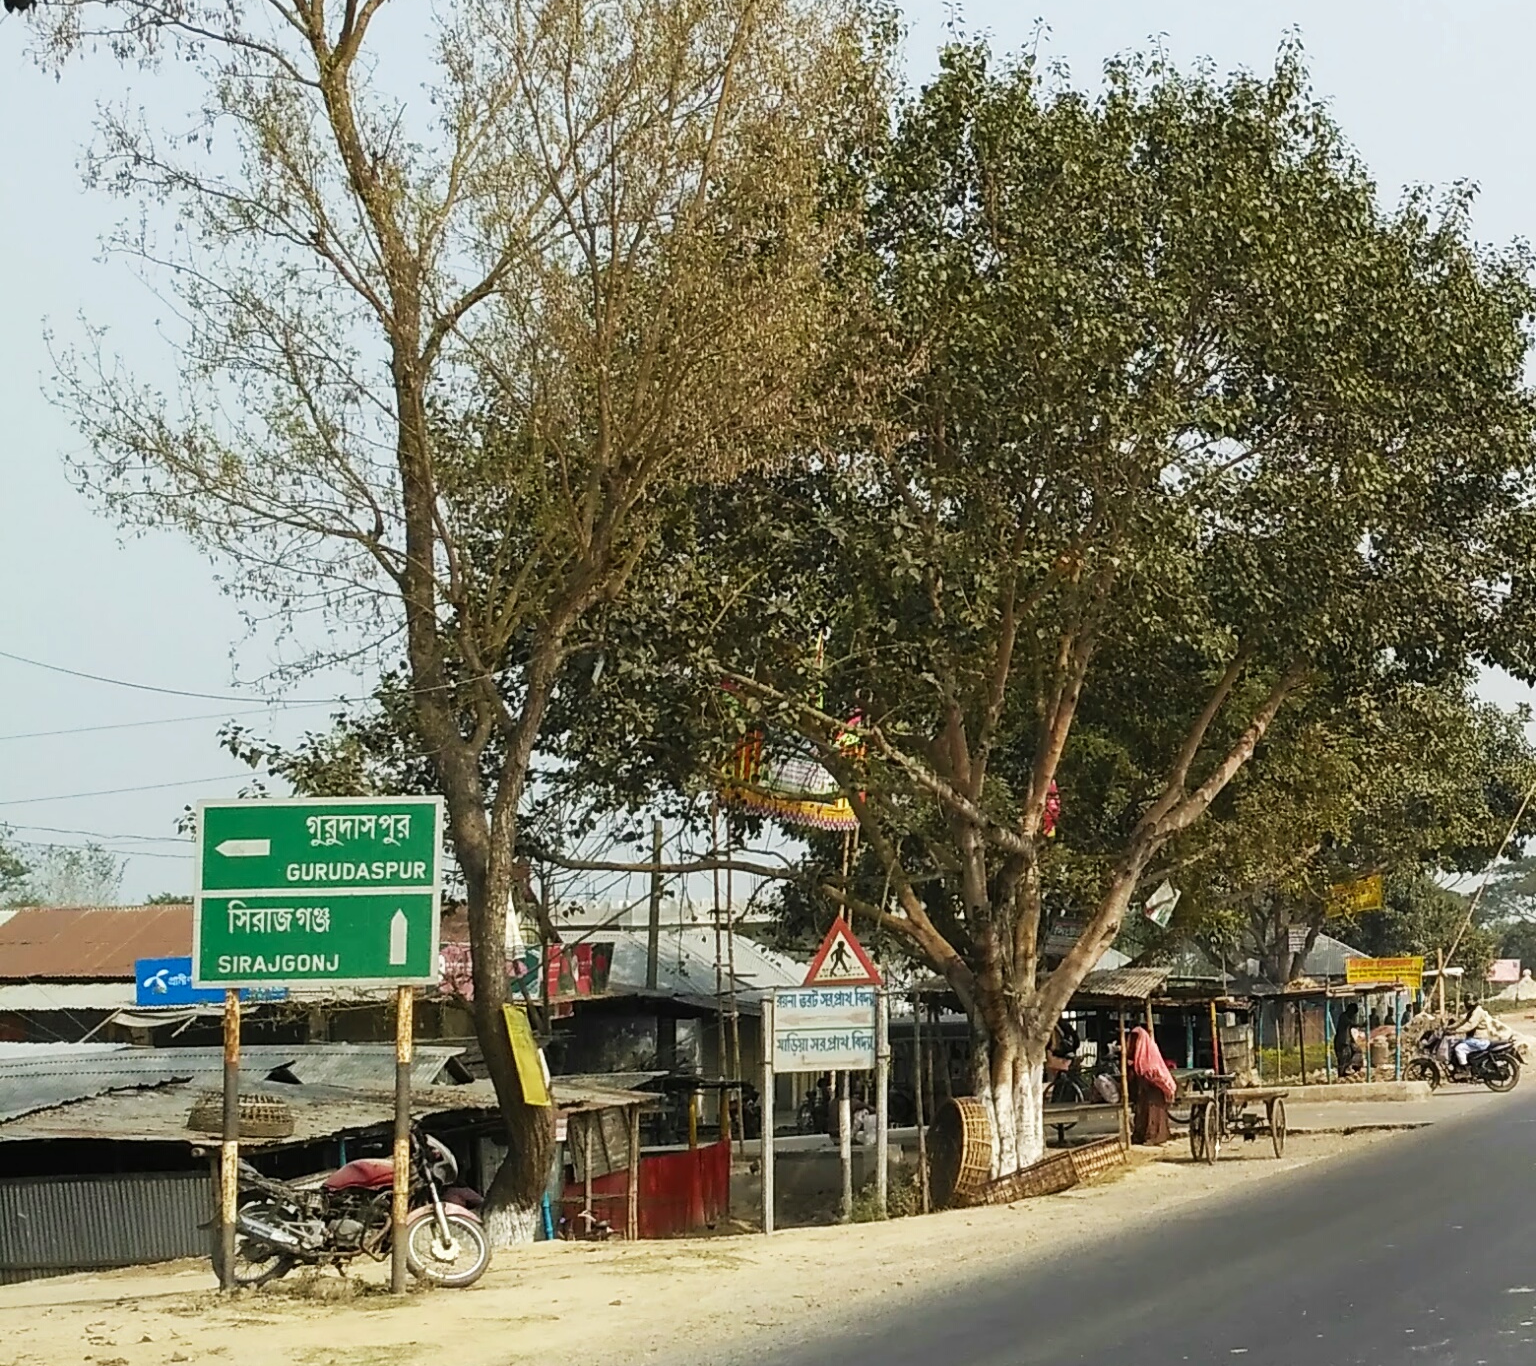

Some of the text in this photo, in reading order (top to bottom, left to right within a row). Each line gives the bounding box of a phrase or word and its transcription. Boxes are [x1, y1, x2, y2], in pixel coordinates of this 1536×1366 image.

[306, 815, 411, 846] গুরুদাসপুর
[286, 862, 426, 881] GURUDASPUR
[218, 954, 340, 974] SIRAJGONJ
